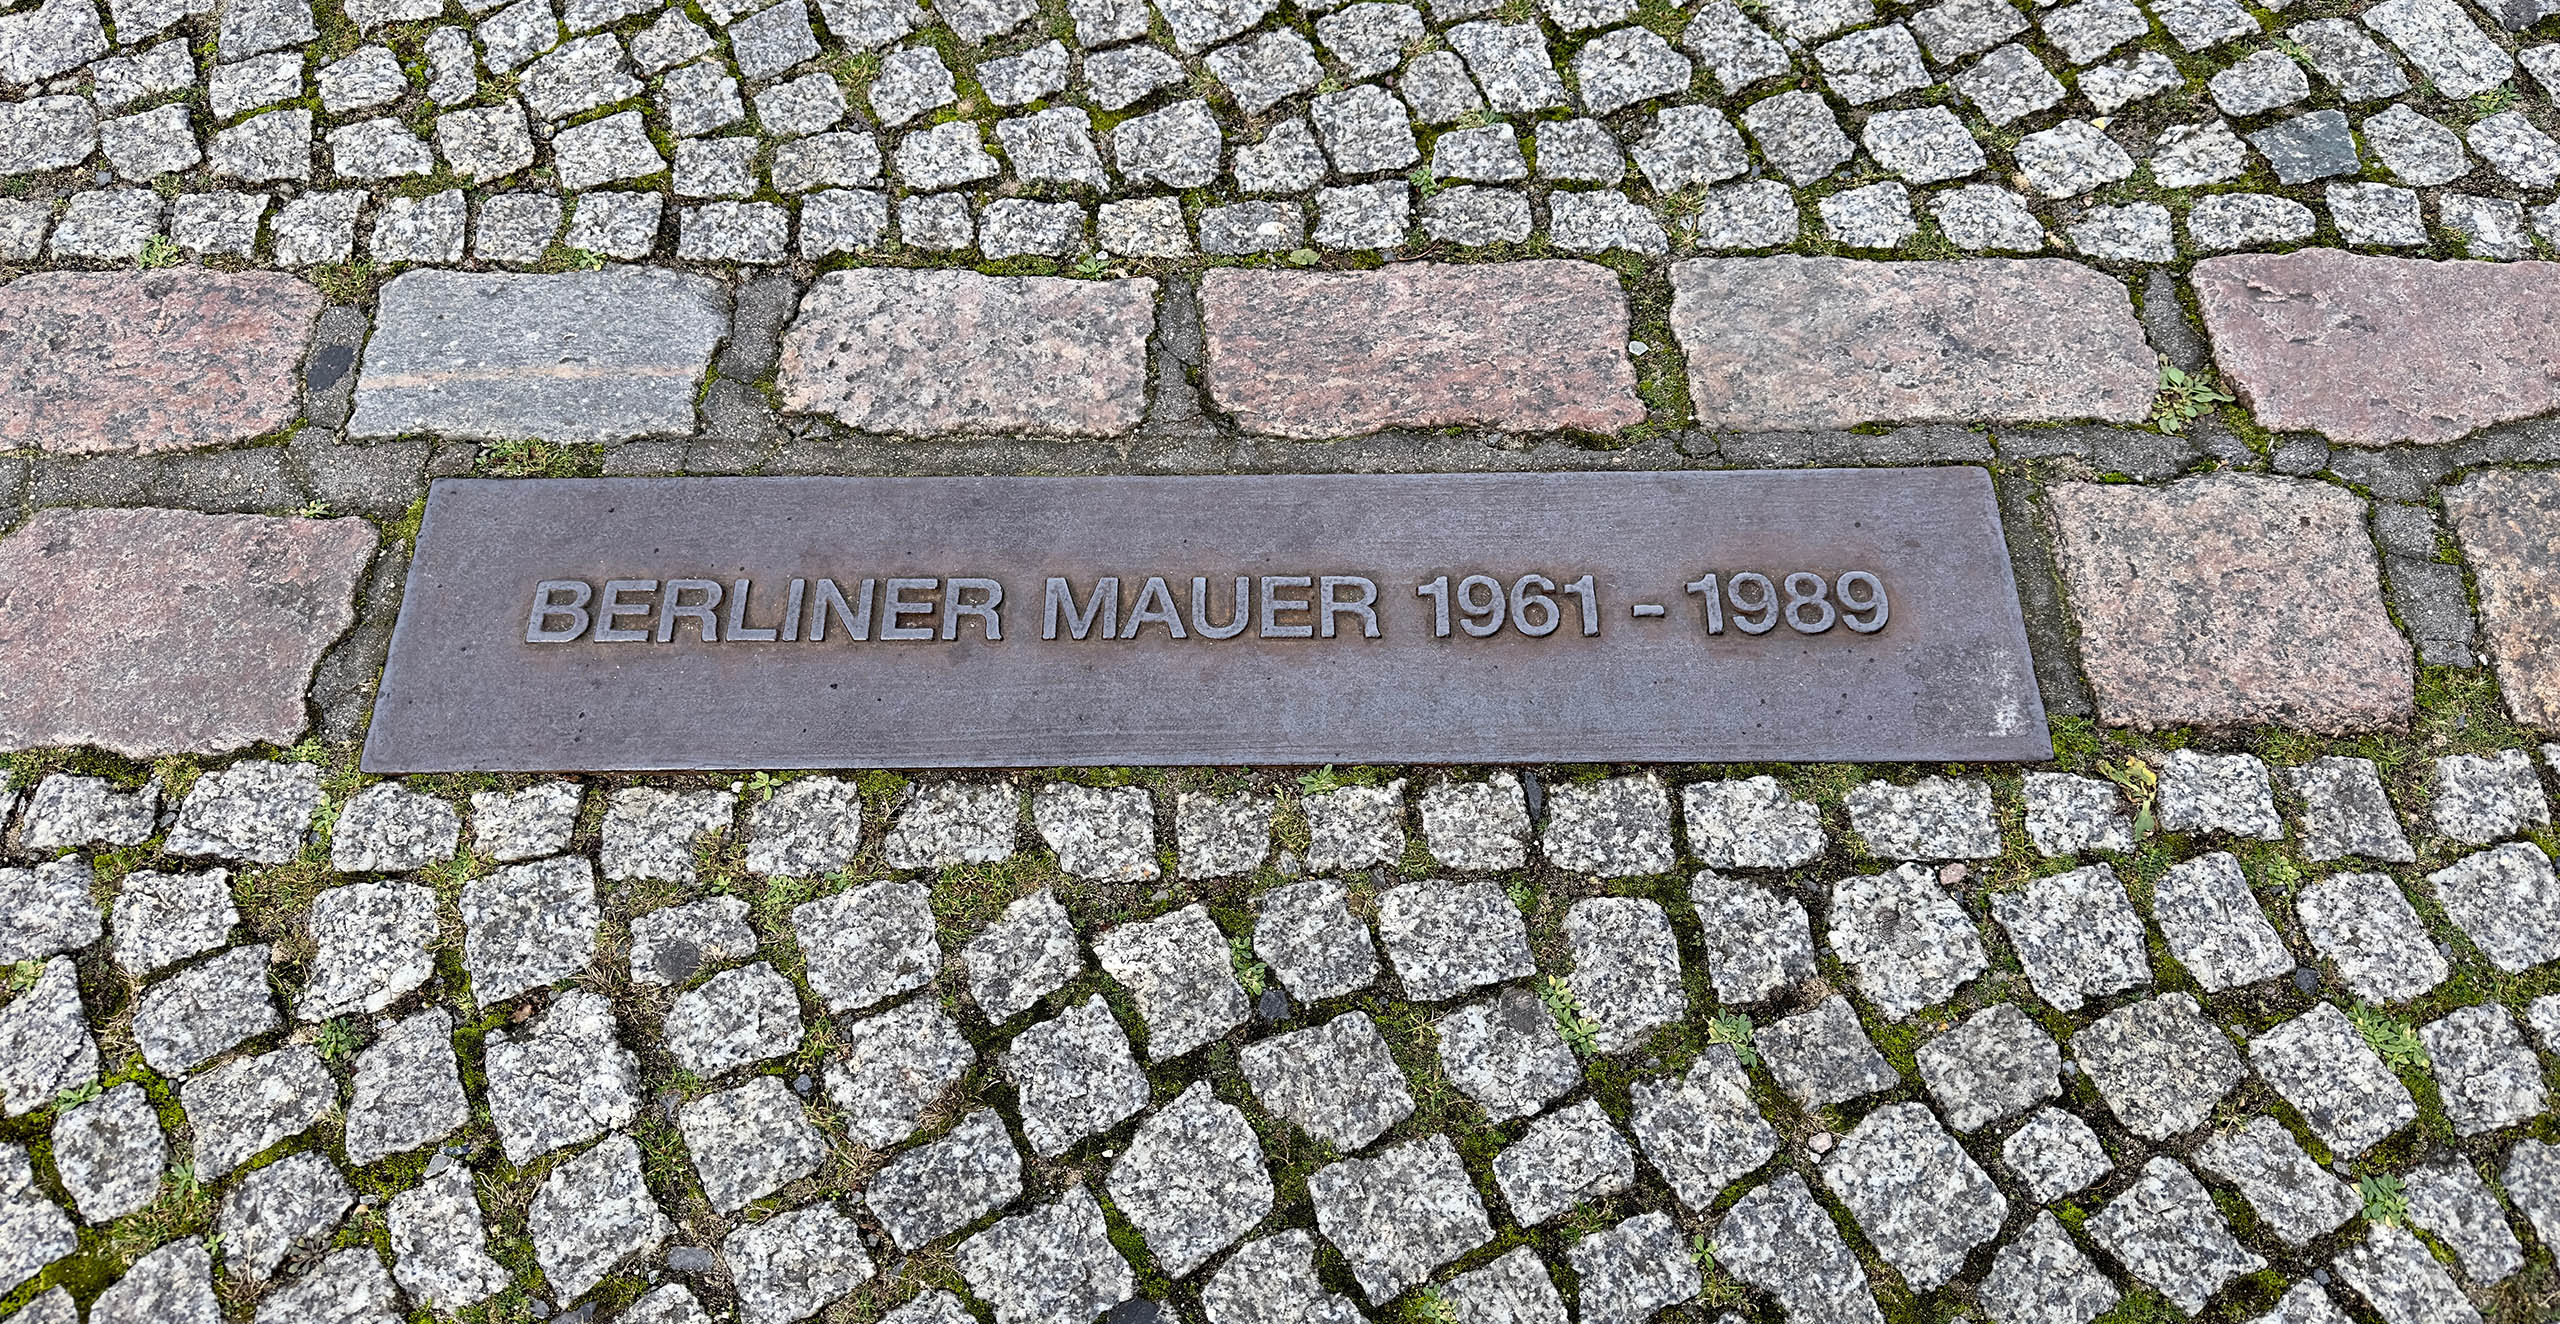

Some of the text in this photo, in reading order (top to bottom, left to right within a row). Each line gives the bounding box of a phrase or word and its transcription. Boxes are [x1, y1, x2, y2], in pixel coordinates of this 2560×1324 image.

[525, 578, 1004, 643] BERLINER
[1041, 576, 1382, 640] MAUER
[1416, 574, 1600, 638] 1961
[1684, 571, 1889, 635] 1989
